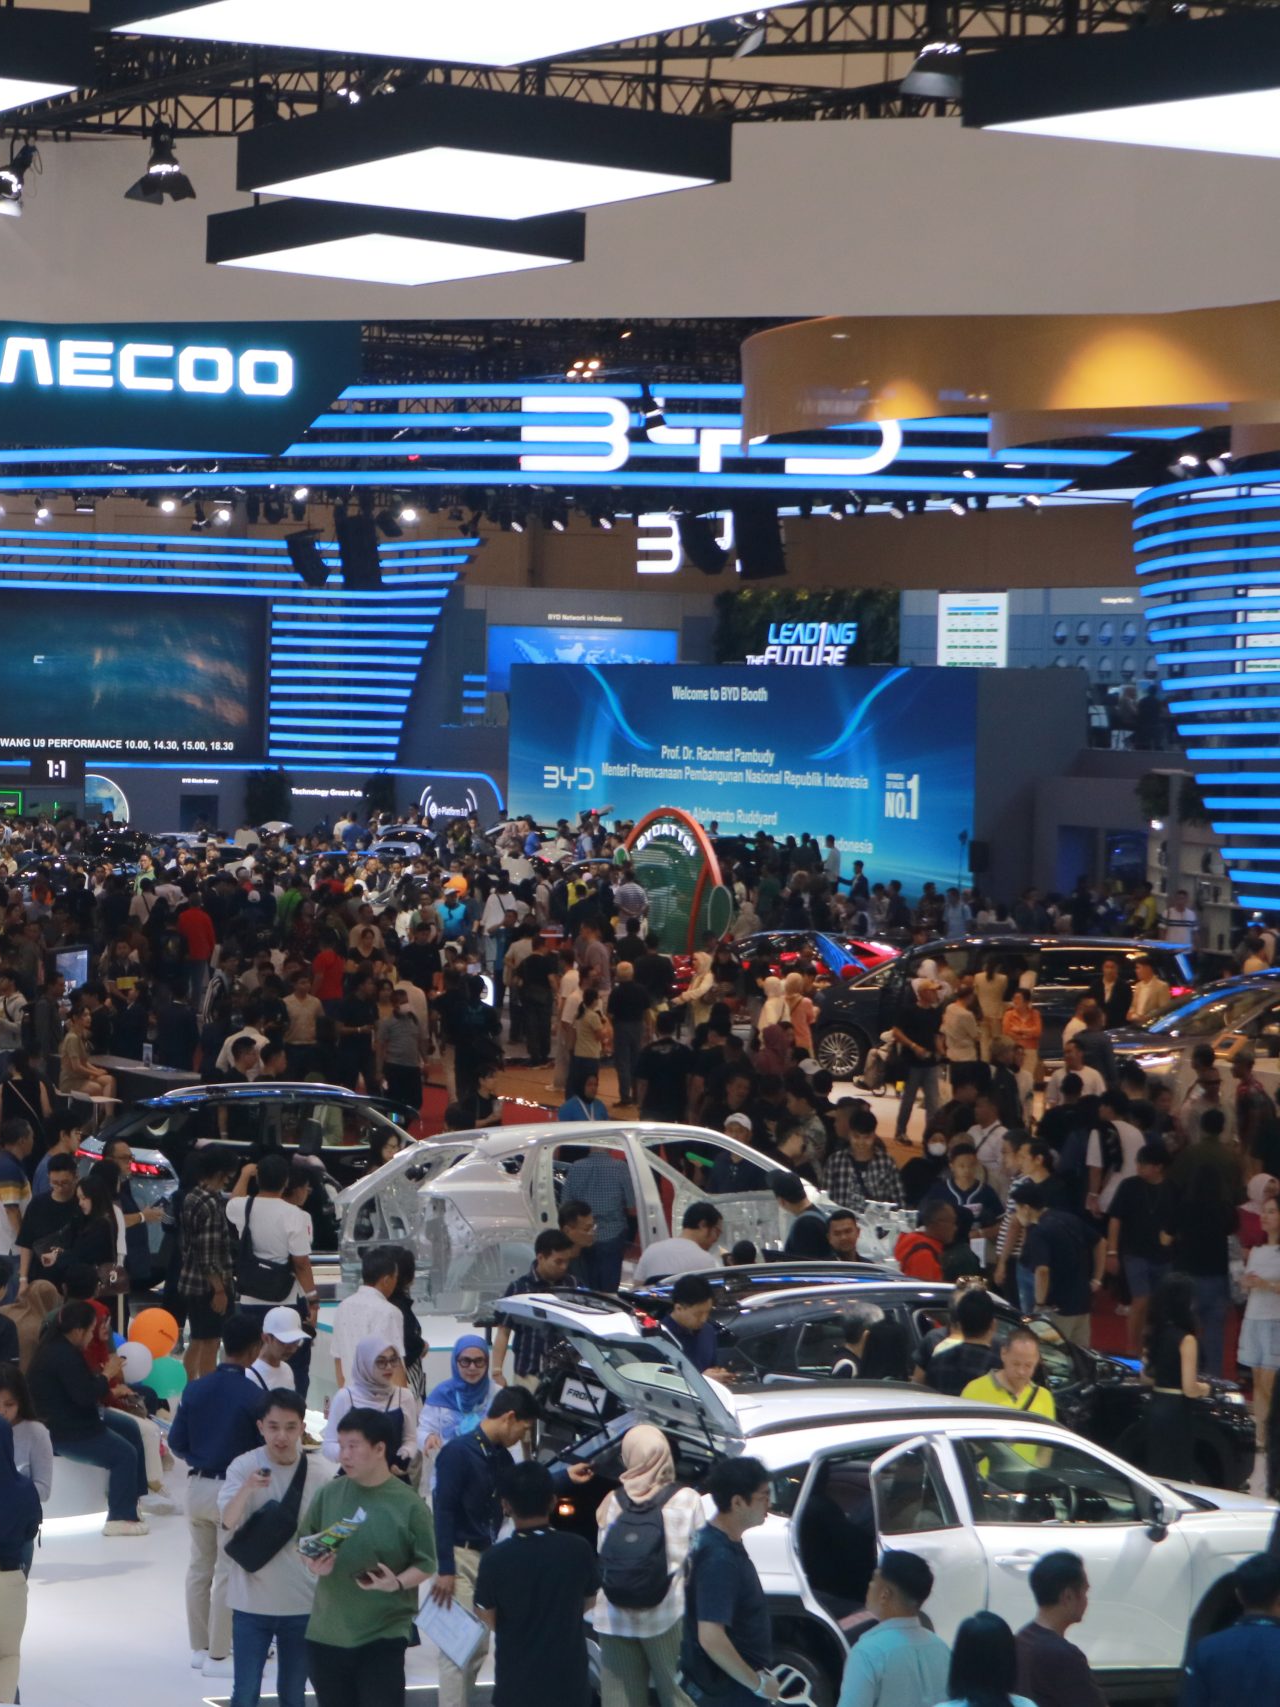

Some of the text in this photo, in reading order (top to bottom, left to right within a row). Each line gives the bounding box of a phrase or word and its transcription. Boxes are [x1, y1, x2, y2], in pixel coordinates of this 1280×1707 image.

[547, 613, 561, 621] BYD
[562, 614, 586, 622] Network
[587, 614, 593, 622] in
[672, 686, 768, 702] Welcome to BYD Booth
[33, 738, 46, 748] U9
[48, 738, 122, 749] PERFORMANCE
[125, 740, 151, 750] 10.00,
[153, 740, 180, 751] 14.30,
[182, 740, 208, 751] 15.00,
[210, 741, 234, 751] 18.30
[661, 745, 775, 767] Prof. Dr. Rachmat Pambudy
[47, 760, 67, 778] 1:1
[544, 766, 595, 790] BYD
[602, 762, 630, 777] Menteri
[631, 764, 683, 779] Perencanaan
[684, 766, 743, 785] Pembangunan
[745, 769, 783, 784] Nasional
[784, 770, 823, 789] Republik
[824, 772, 869, 789] Indonesia
[291, 787, 329, 797] Technology
[329, 789, 349, 797] Green
[736, 809, 778, 828] Ruddyard
